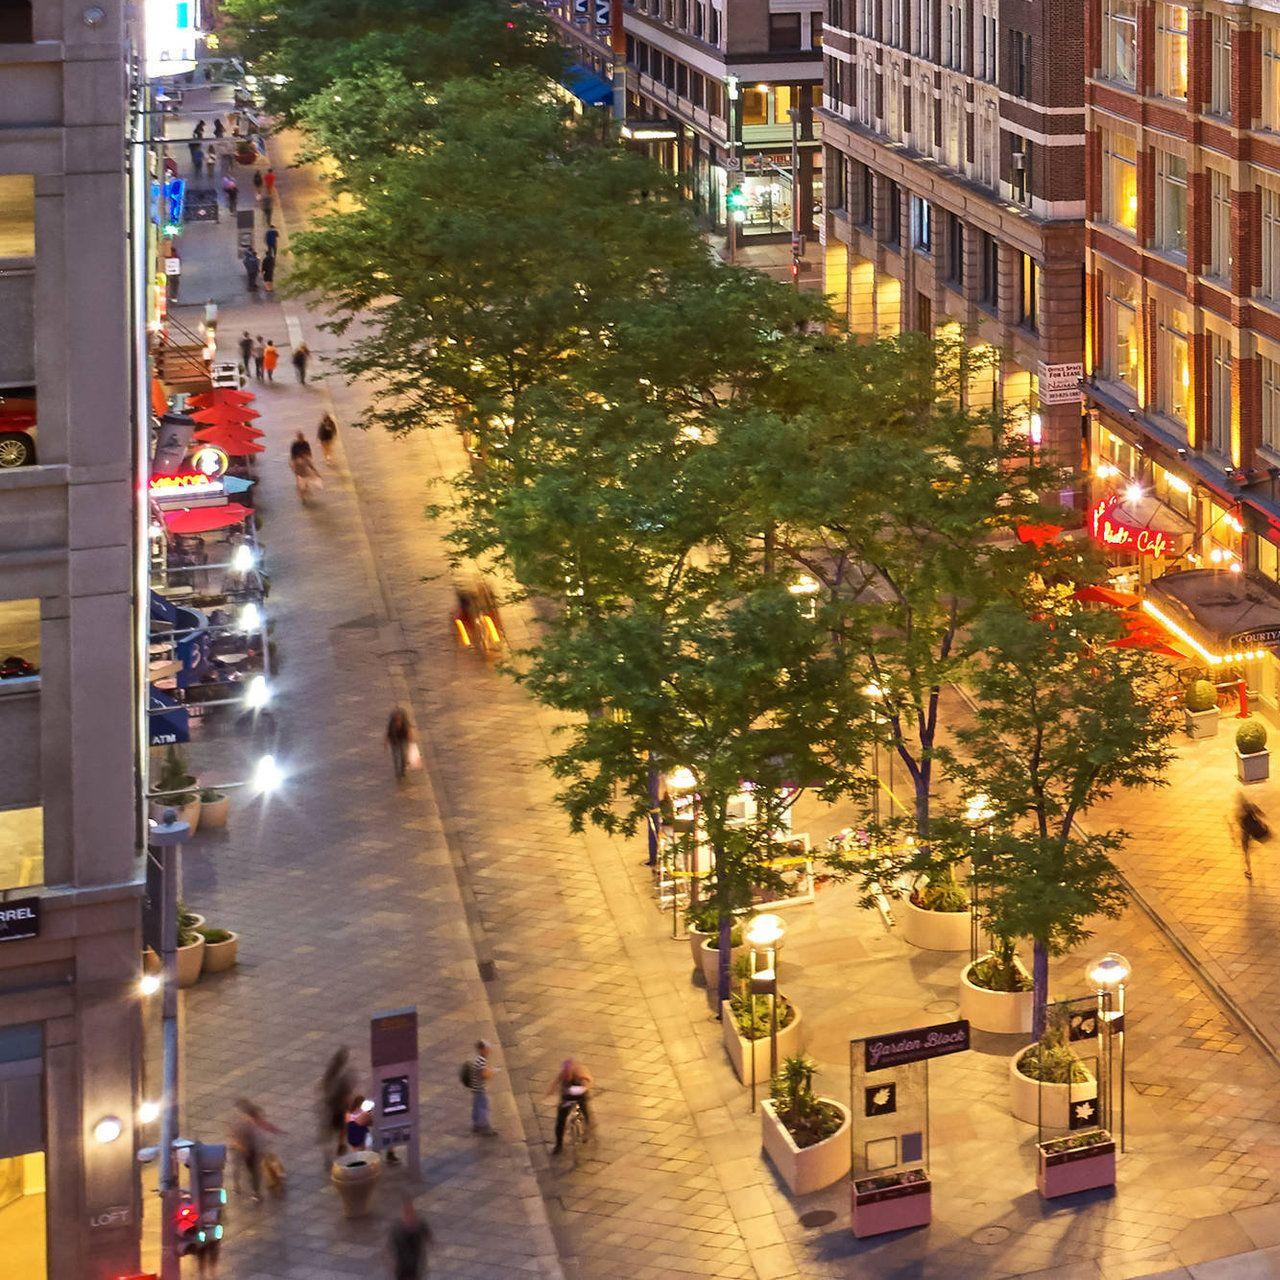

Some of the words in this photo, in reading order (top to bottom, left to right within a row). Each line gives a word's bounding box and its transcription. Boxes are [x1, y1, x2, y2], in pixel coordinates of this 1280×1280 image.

[152, 733, 176, 745] ATM
[869, 1039, 921, 1066] Garden
[924, 1029, 966, 1048] Block
[91, 1210, 129, 1227] LOFT
